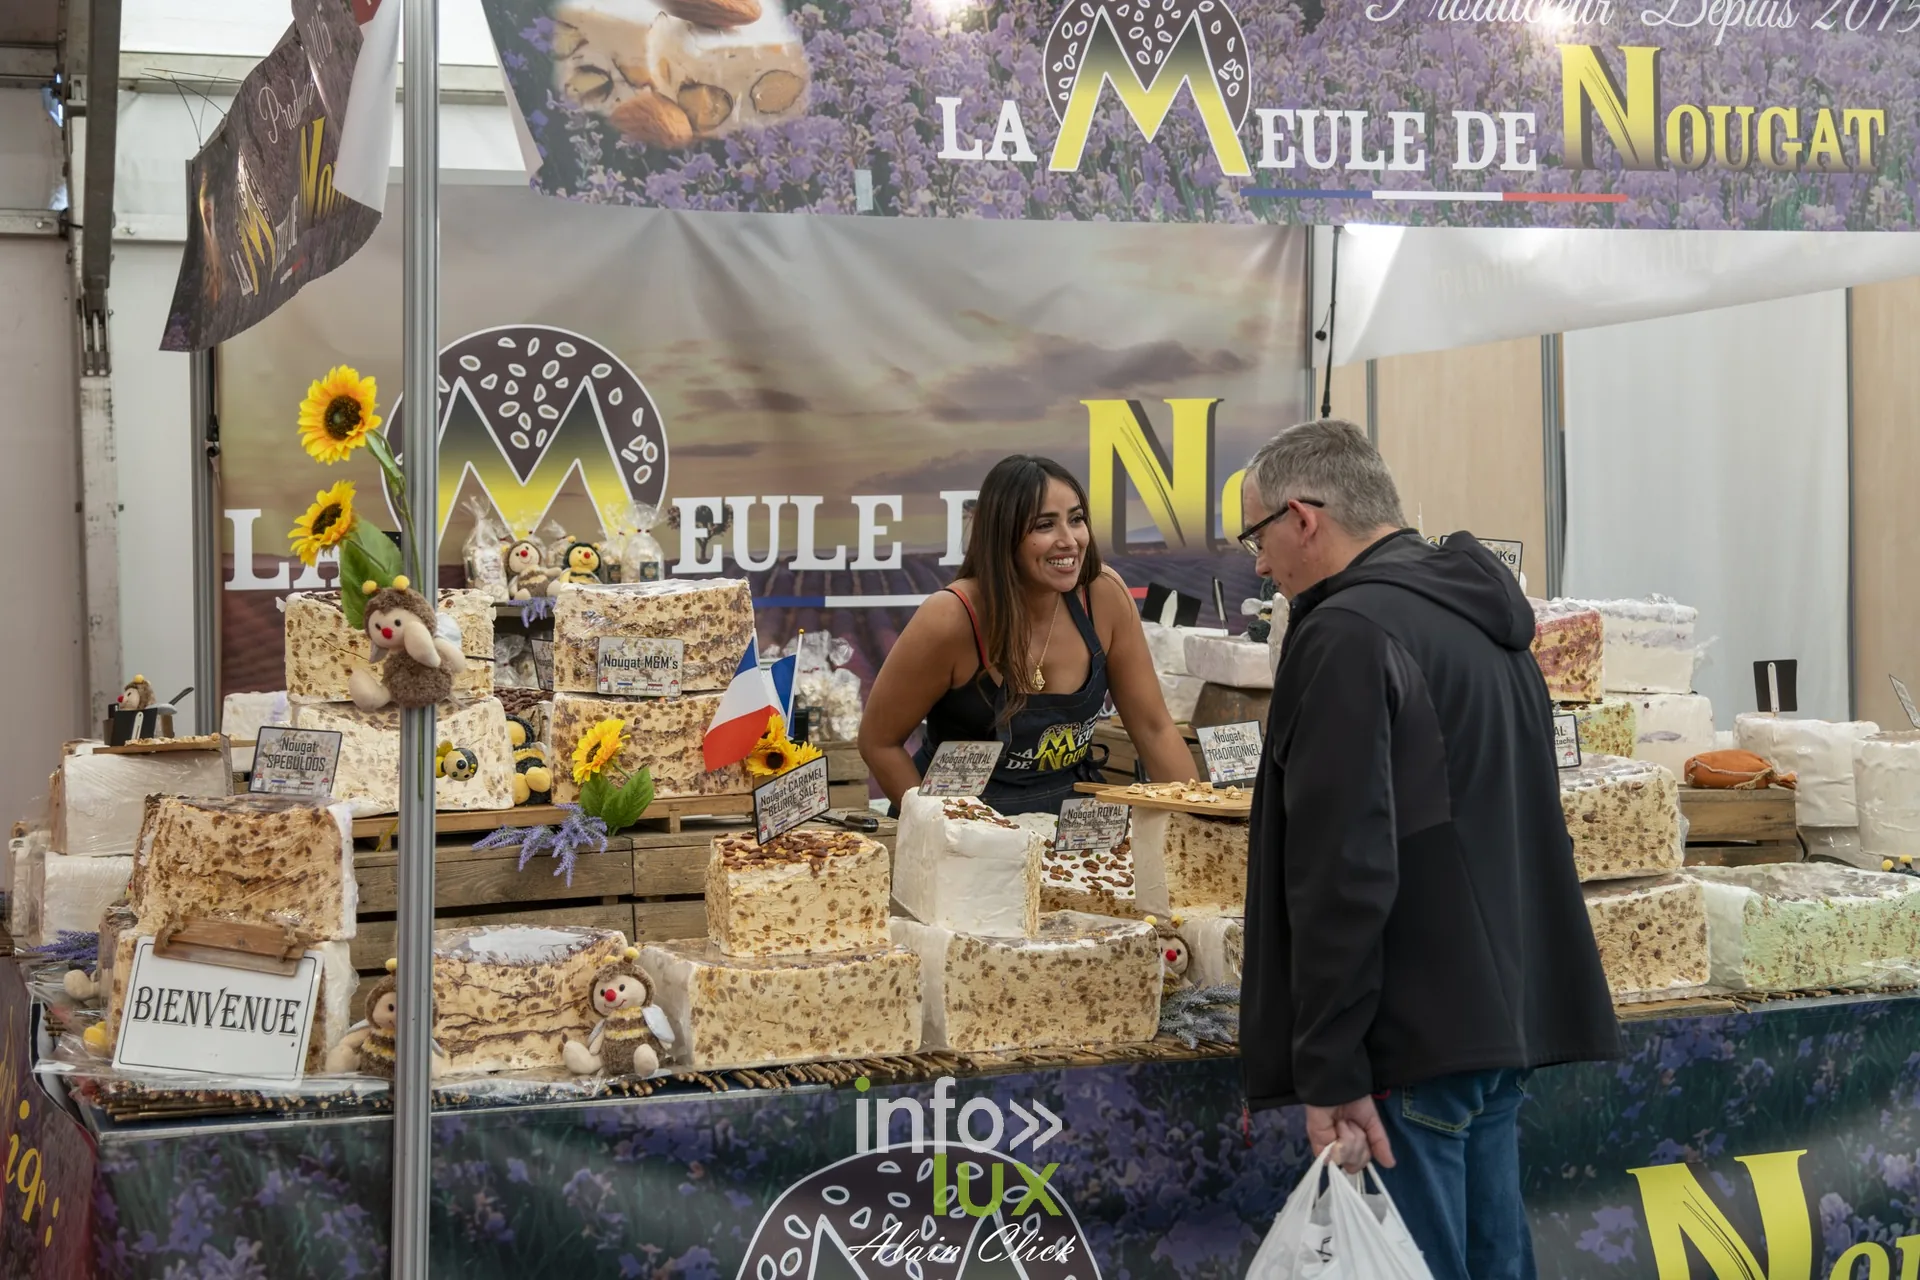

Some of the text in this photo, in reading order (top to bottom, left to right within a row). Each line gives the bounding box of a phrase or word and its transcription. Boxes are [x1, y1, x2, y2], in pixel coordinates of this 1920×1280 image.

[936, 96, 1038, 163] LA
[1452, 109, 1537, 172] DE
[1555, 43, 1887, 174] NOUGAT
[604, 654, 679, 671] Nougat M&M's
[281, 737, 317, 755] Nougat
[1213, 730, 1242, 745] Nougat
[939, 753, 967, 769] Nougat
[1207, 743, 1262, 761] TRADITIONNEL
[760, 767, 823, 808] Nougat CARAMEL
[768, 792, 797, 817] BEURRE
[1067, 805, 1123, 820] Nougat ROYAL
[132, 986, 301, 1036] BIENVENUE
